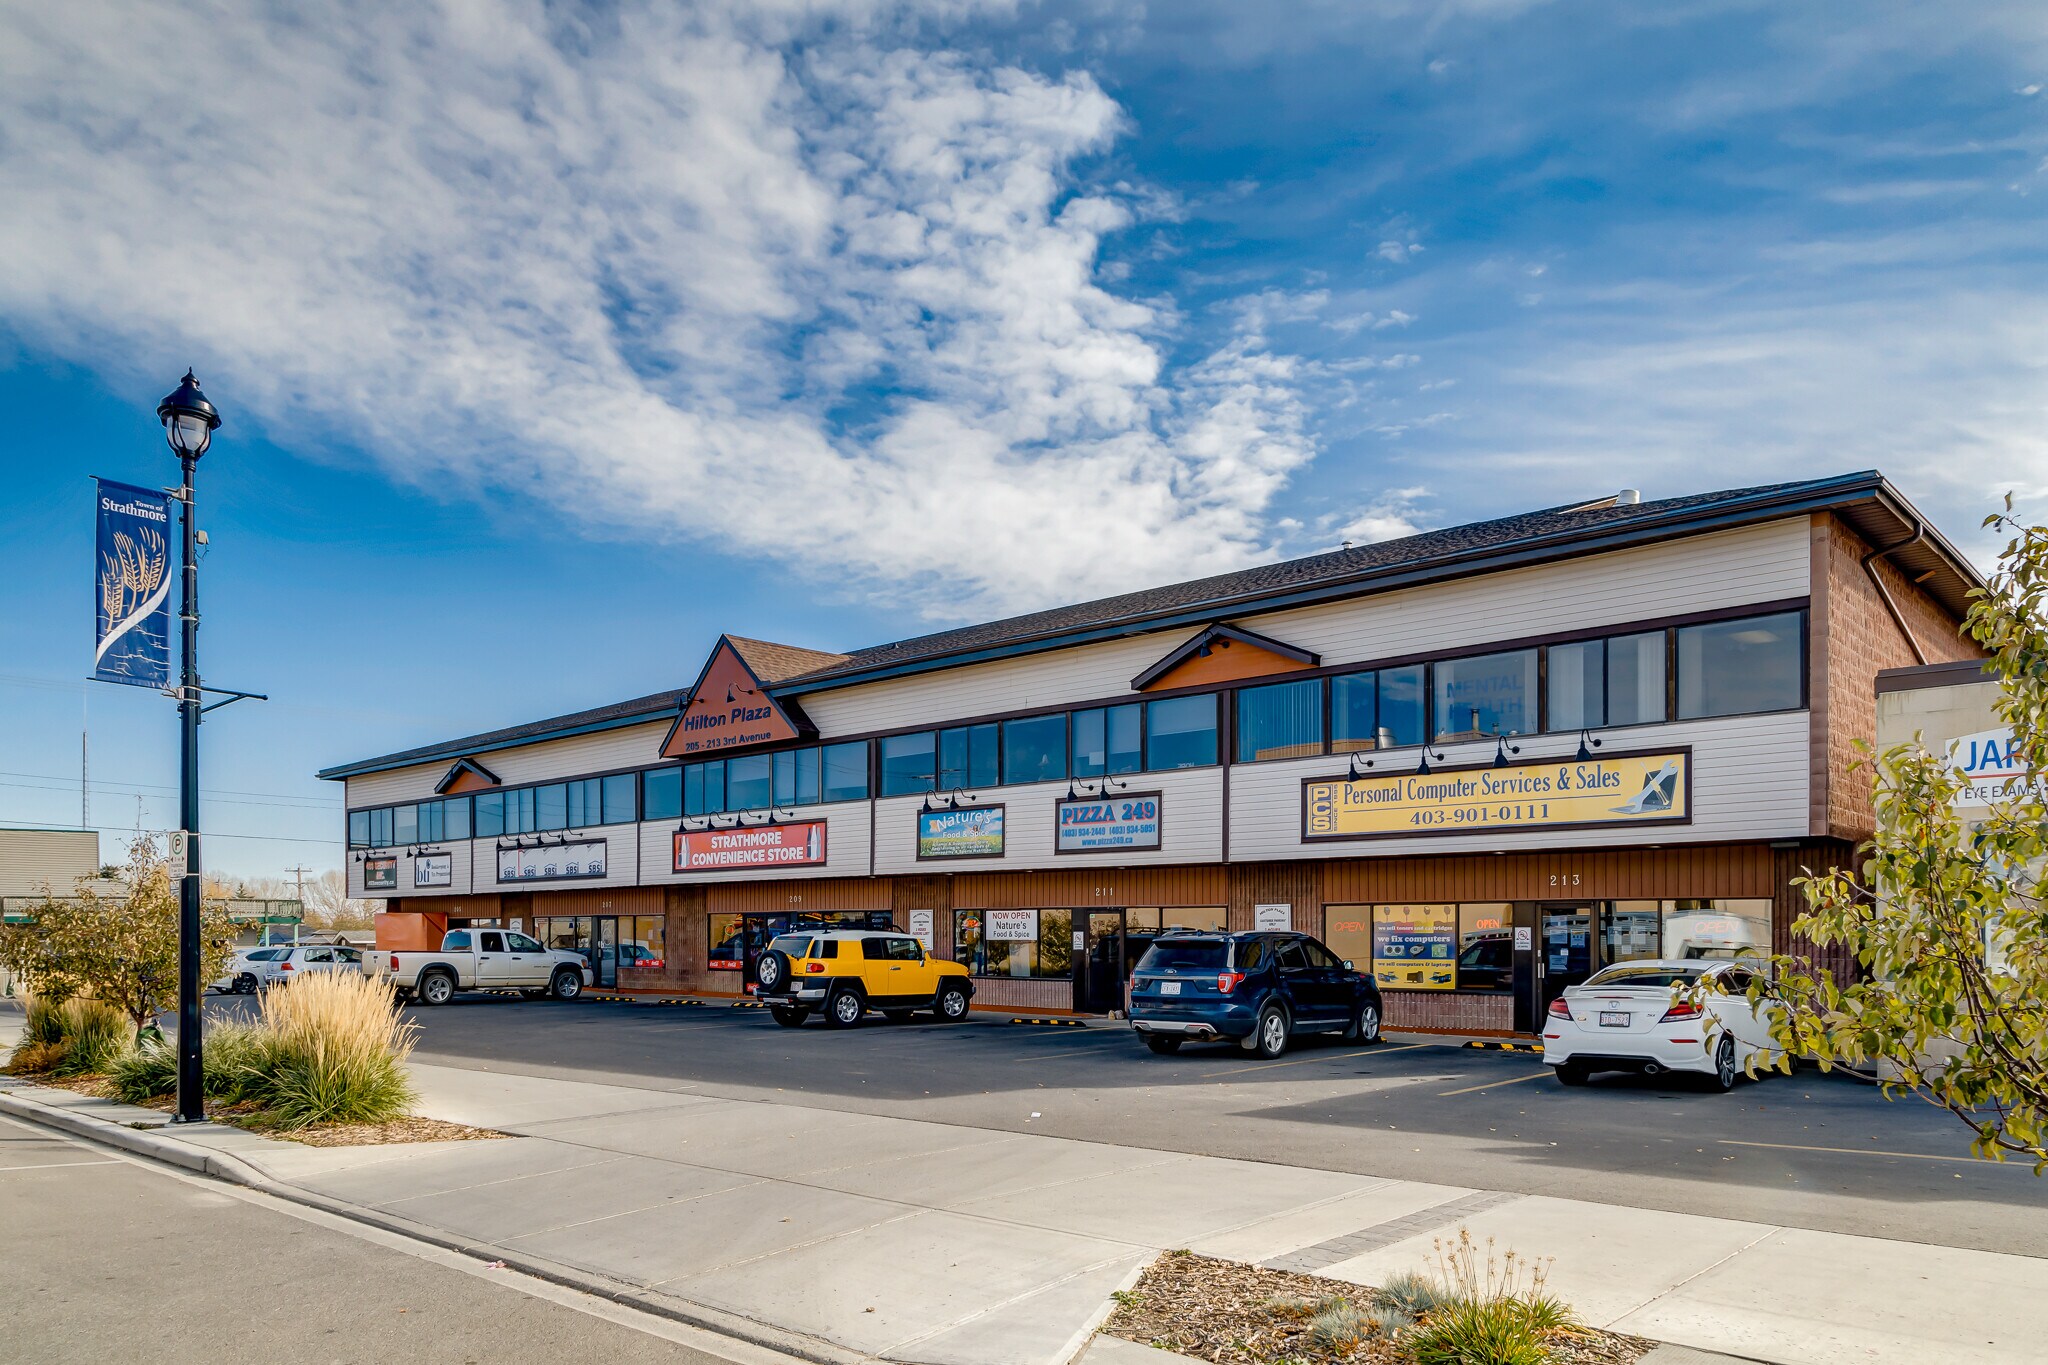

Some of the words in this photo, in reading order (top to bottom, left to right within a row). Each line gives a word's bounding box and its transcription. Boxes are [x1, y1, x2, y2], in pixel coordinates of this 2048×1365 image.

[101, 497, 167, 522] Strathmore
[134, 499, 155, 510] Town
[1446, 674, 1523, 698] MENTAL
[684, 713, 727, 731] Hilton
[730, 706, 772, 724] Plaza
[685, 741, 700, 752] 205
[706, 738, 721, 749] 213
[723, 735, 737, 746] 3rd
[738, 731, 771, 743] Avenue
[1343, 779, 1402, 805] Personal
[1407, 778, 1477, 802] Computer
[1481, 771, 1550, 796] Services
[1556, 766, 1571, 790] &
[1576, 764, 1620, 789] Sales
[1964, 786, 1988, 799] EYE
[1992, 783, 2038, 798] EXAMS
[1061, 804, 1117, 827] PIZZA
[1121, 801, 1156, 822] 249
[1312, 787, 1330, 831] PCS
[1410, 803, 1549, 825] 403-901-0111
[936, 809, 991, 832] Nature's
[711, 831, 782, 849] STRATHMORE
[942, 830, 961, 838] Food
[969, 829, 990, 839] Spice
[1081, 836, 1133, 846] www.pizza249.ca
[691, 849, 766, 866] CONVENIENCE
[767, 846, 804, 862] STORE
[1550, 874, 1580, 886] 213
[789, 895, 802, 903] 209
[1095, 887, 1113, 897] 211
[992, 912, 1009, 920] NOW
[1010, 911, 1031, 920] OPEN
[995, 921, 1027, 930] Nature's
[1333, 921, 1366, 933] OPEN
[1476, 918, 1500, 930] OPEN
[1695, 920, 1740, 934] OPEN
[993, 930, 1008, 938] Food
[1008, 930, 1013, 938] &
[1014, 930, 1030, 939] Spice
[1391, 935, 1404, 943] fix
[1404, 935, 1451, 944] computers
